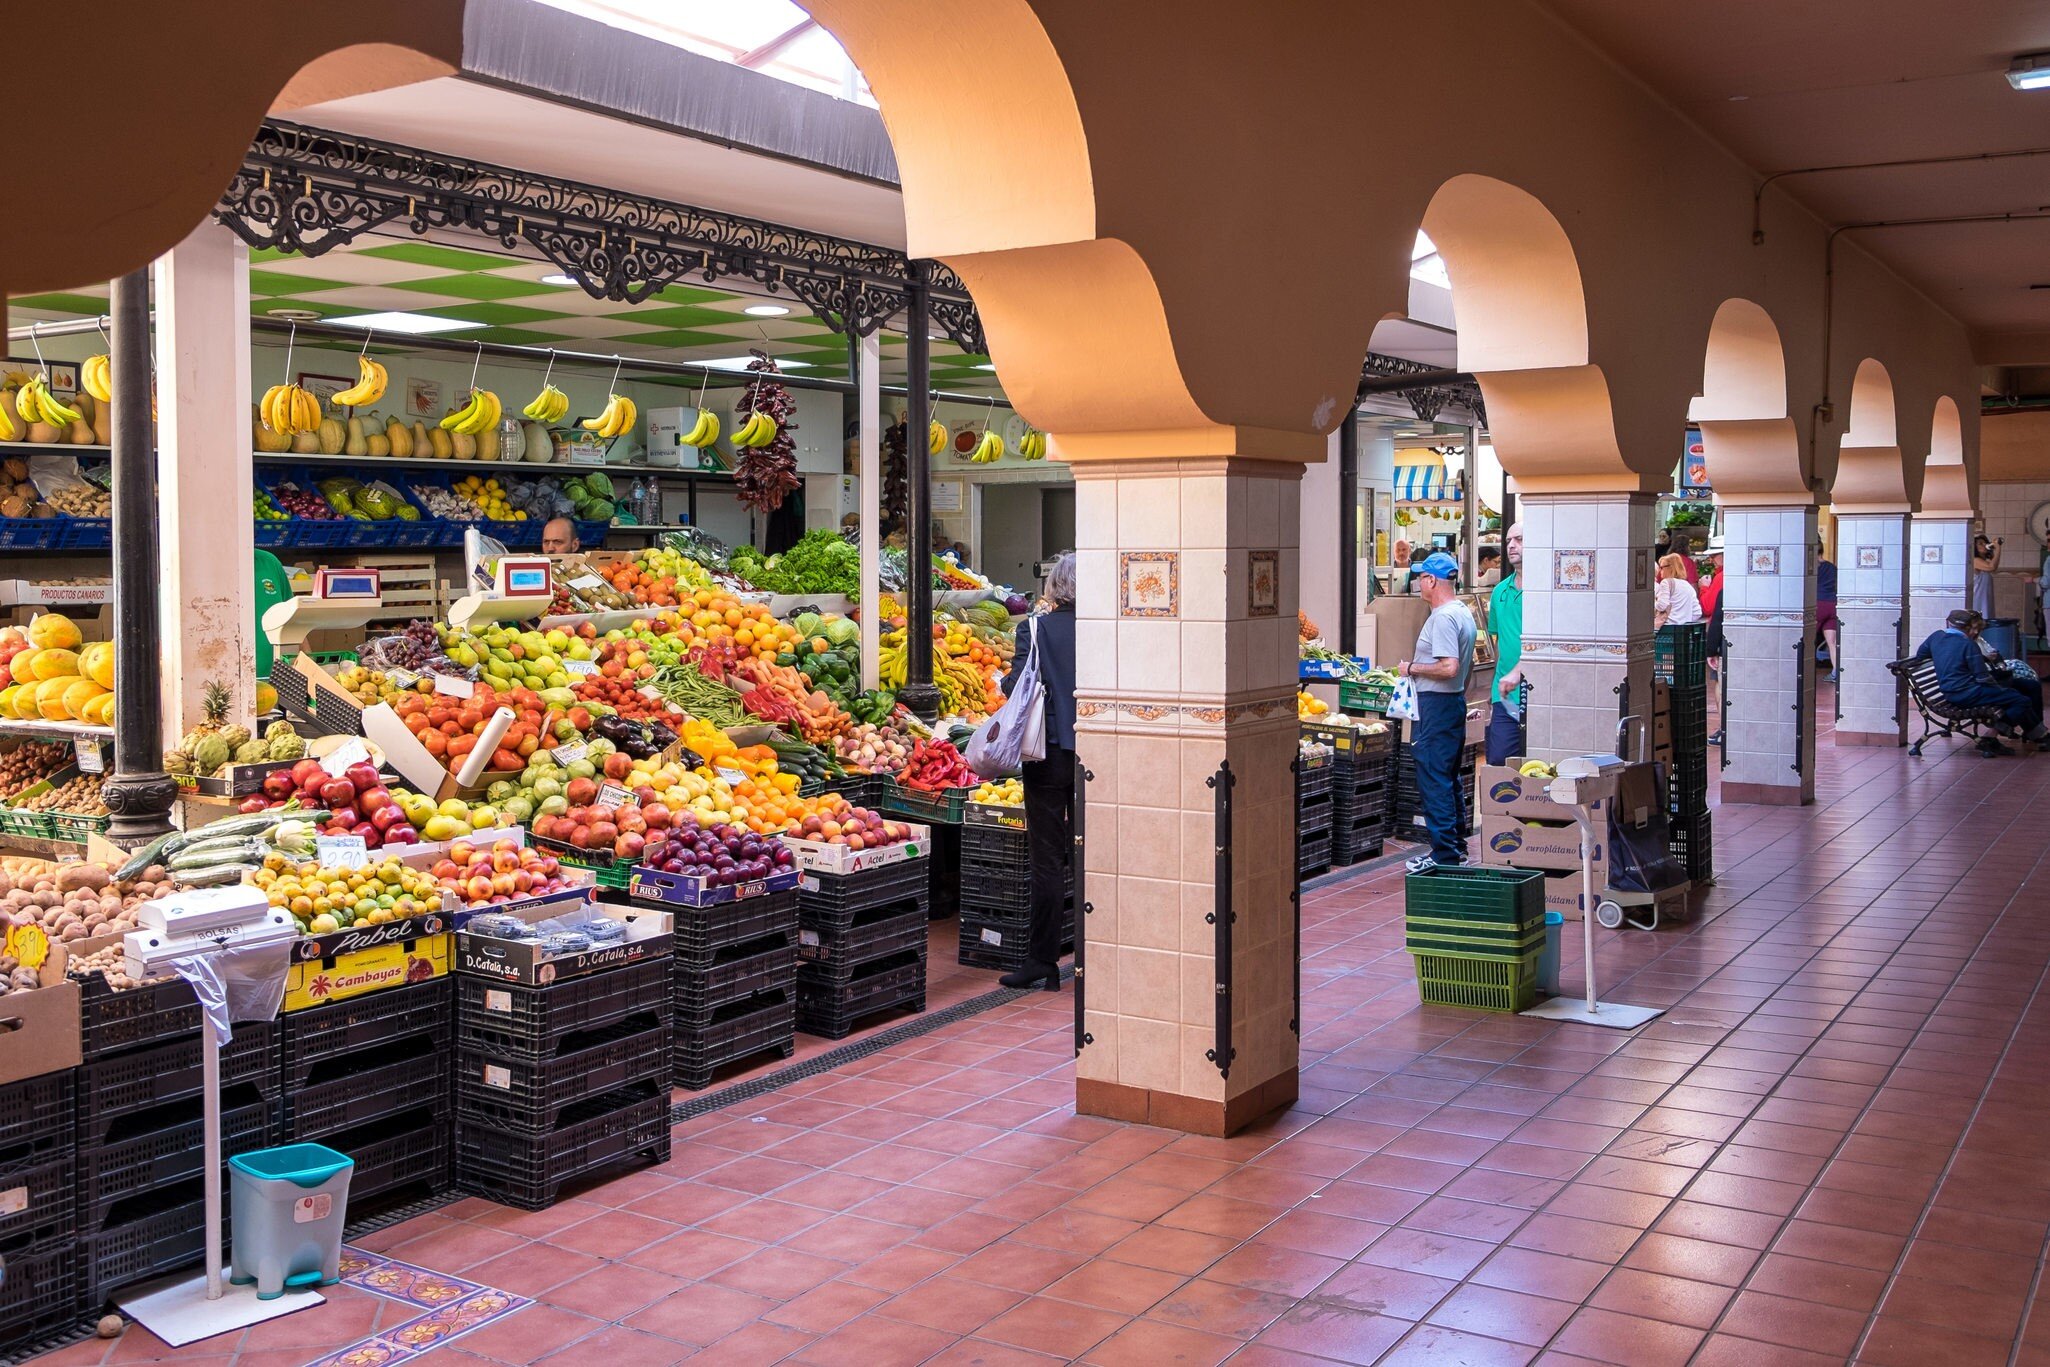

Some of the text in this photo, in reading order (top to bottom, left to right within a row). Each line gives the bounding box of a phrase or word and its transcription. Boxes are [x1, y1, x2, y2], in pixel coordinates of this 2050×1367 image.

[41, 589, 105, 600] PRODUCTOS CANARIOS
[176, 776, 197, 787] aria
[998, 816, 1022, 825] Frutaria
[1526, 845, 1577, 855] europlátano
[804, 857, 814, 865] tel
[868, 853, 884, 865] Actel
[639, 886, 659, 896] RIUS
[744, 884, 763, 895] RIUS
[198, 926, 239, 940] BOLSAS
[331, 919, 412, 955] Pabel
[335, 967, 402, 989] Cambayas
